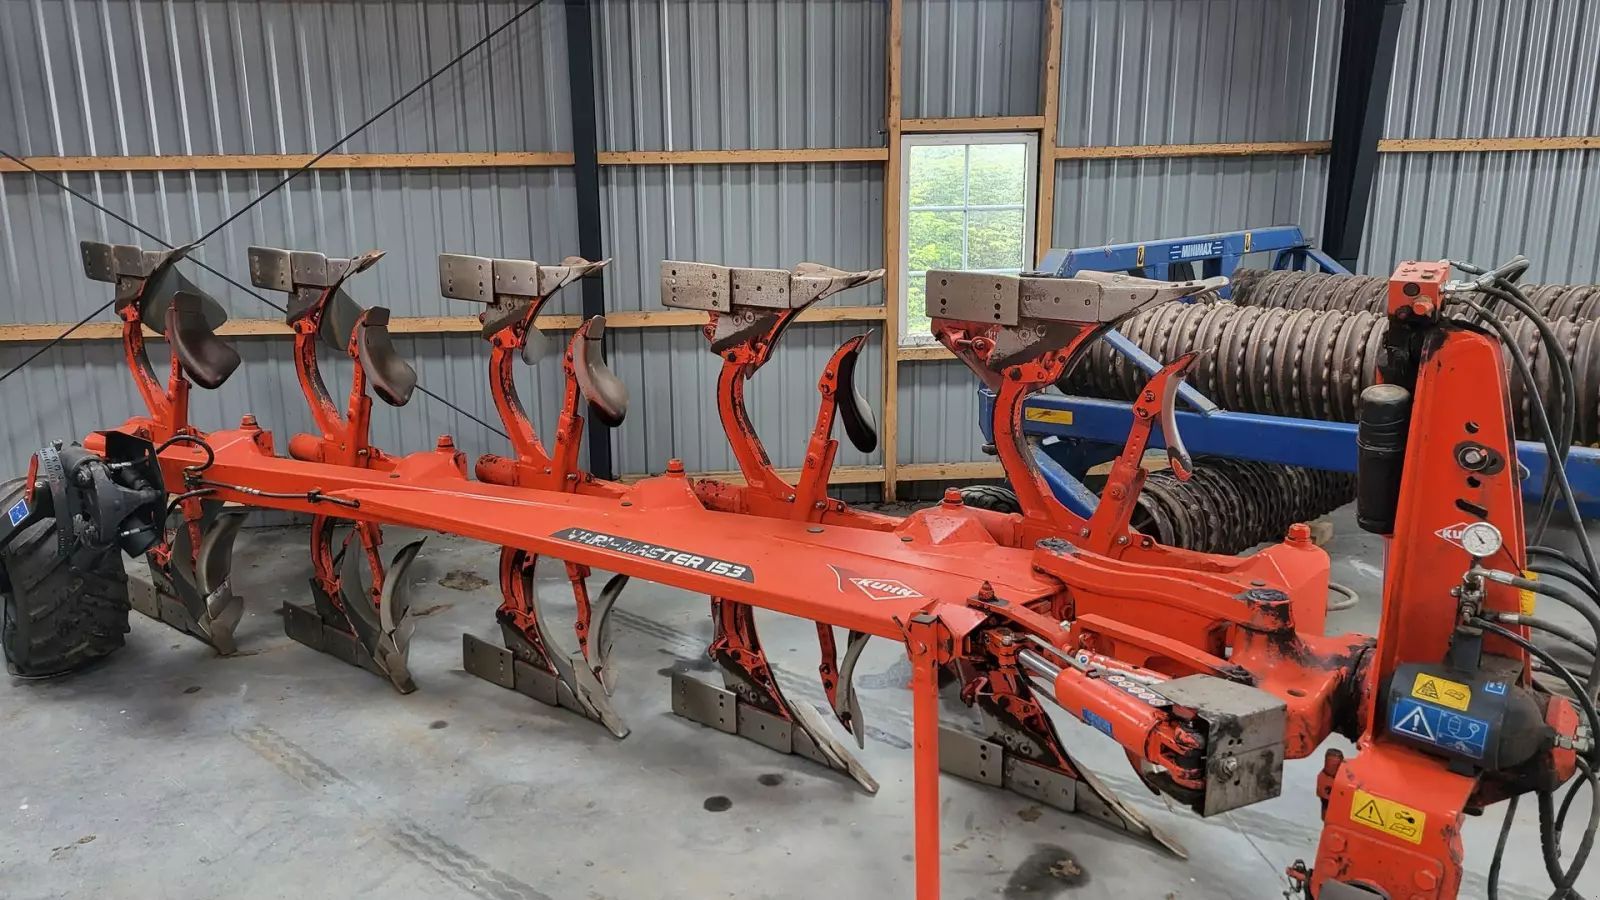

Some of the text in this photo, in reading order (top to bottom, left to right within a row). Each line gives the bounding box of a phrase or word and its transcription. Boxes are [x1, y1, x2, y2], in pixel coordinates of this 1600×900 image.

[1181, 242, 1213, 257] MINIMAX
[705, 561, 747, 578] 153
[858, 579, 912, 597] KUHN
